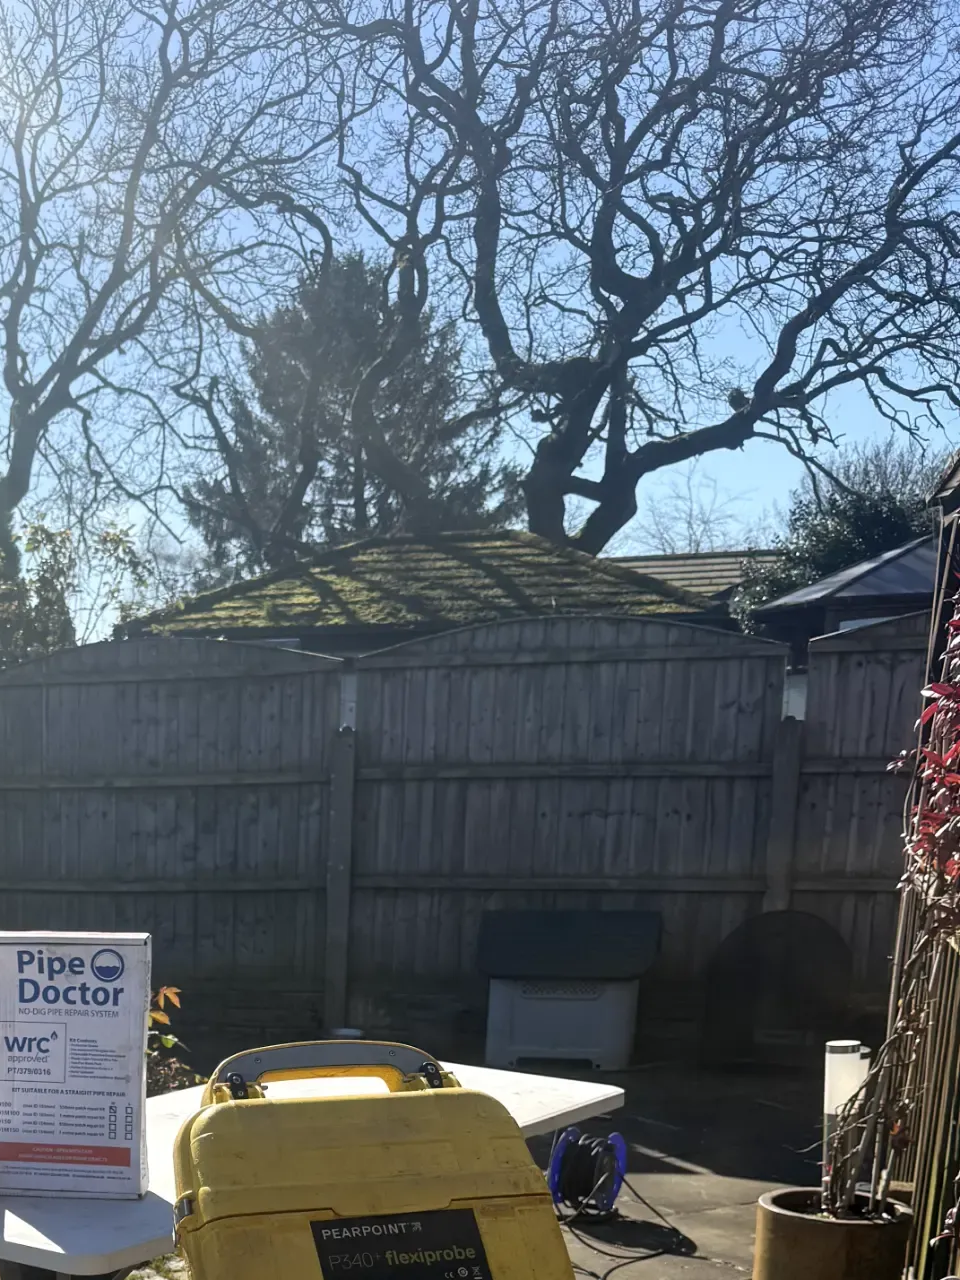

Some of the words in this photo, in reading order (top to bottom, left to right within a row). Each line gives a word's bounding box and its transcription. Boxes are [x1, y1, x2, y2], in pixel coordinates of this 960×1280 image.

[16, 949, 85, 981] Pipe
[18, 978, 125, 1007] Doctor
[18, 1007, 47, 1016] NO-DIG
[47, 1008, 63, 1016] PIPE
[64, 1009, 90, 1017] REPAIR
[90, 1010, 119, 1018] SYSTEM
[4, 1035, 51, 1054] wrc
[7, 1053, 48, 1063] approved
[321, 1222, 407, 1240] PEARPOINT
[385, 1245, 476, 1266] flexiprobe
